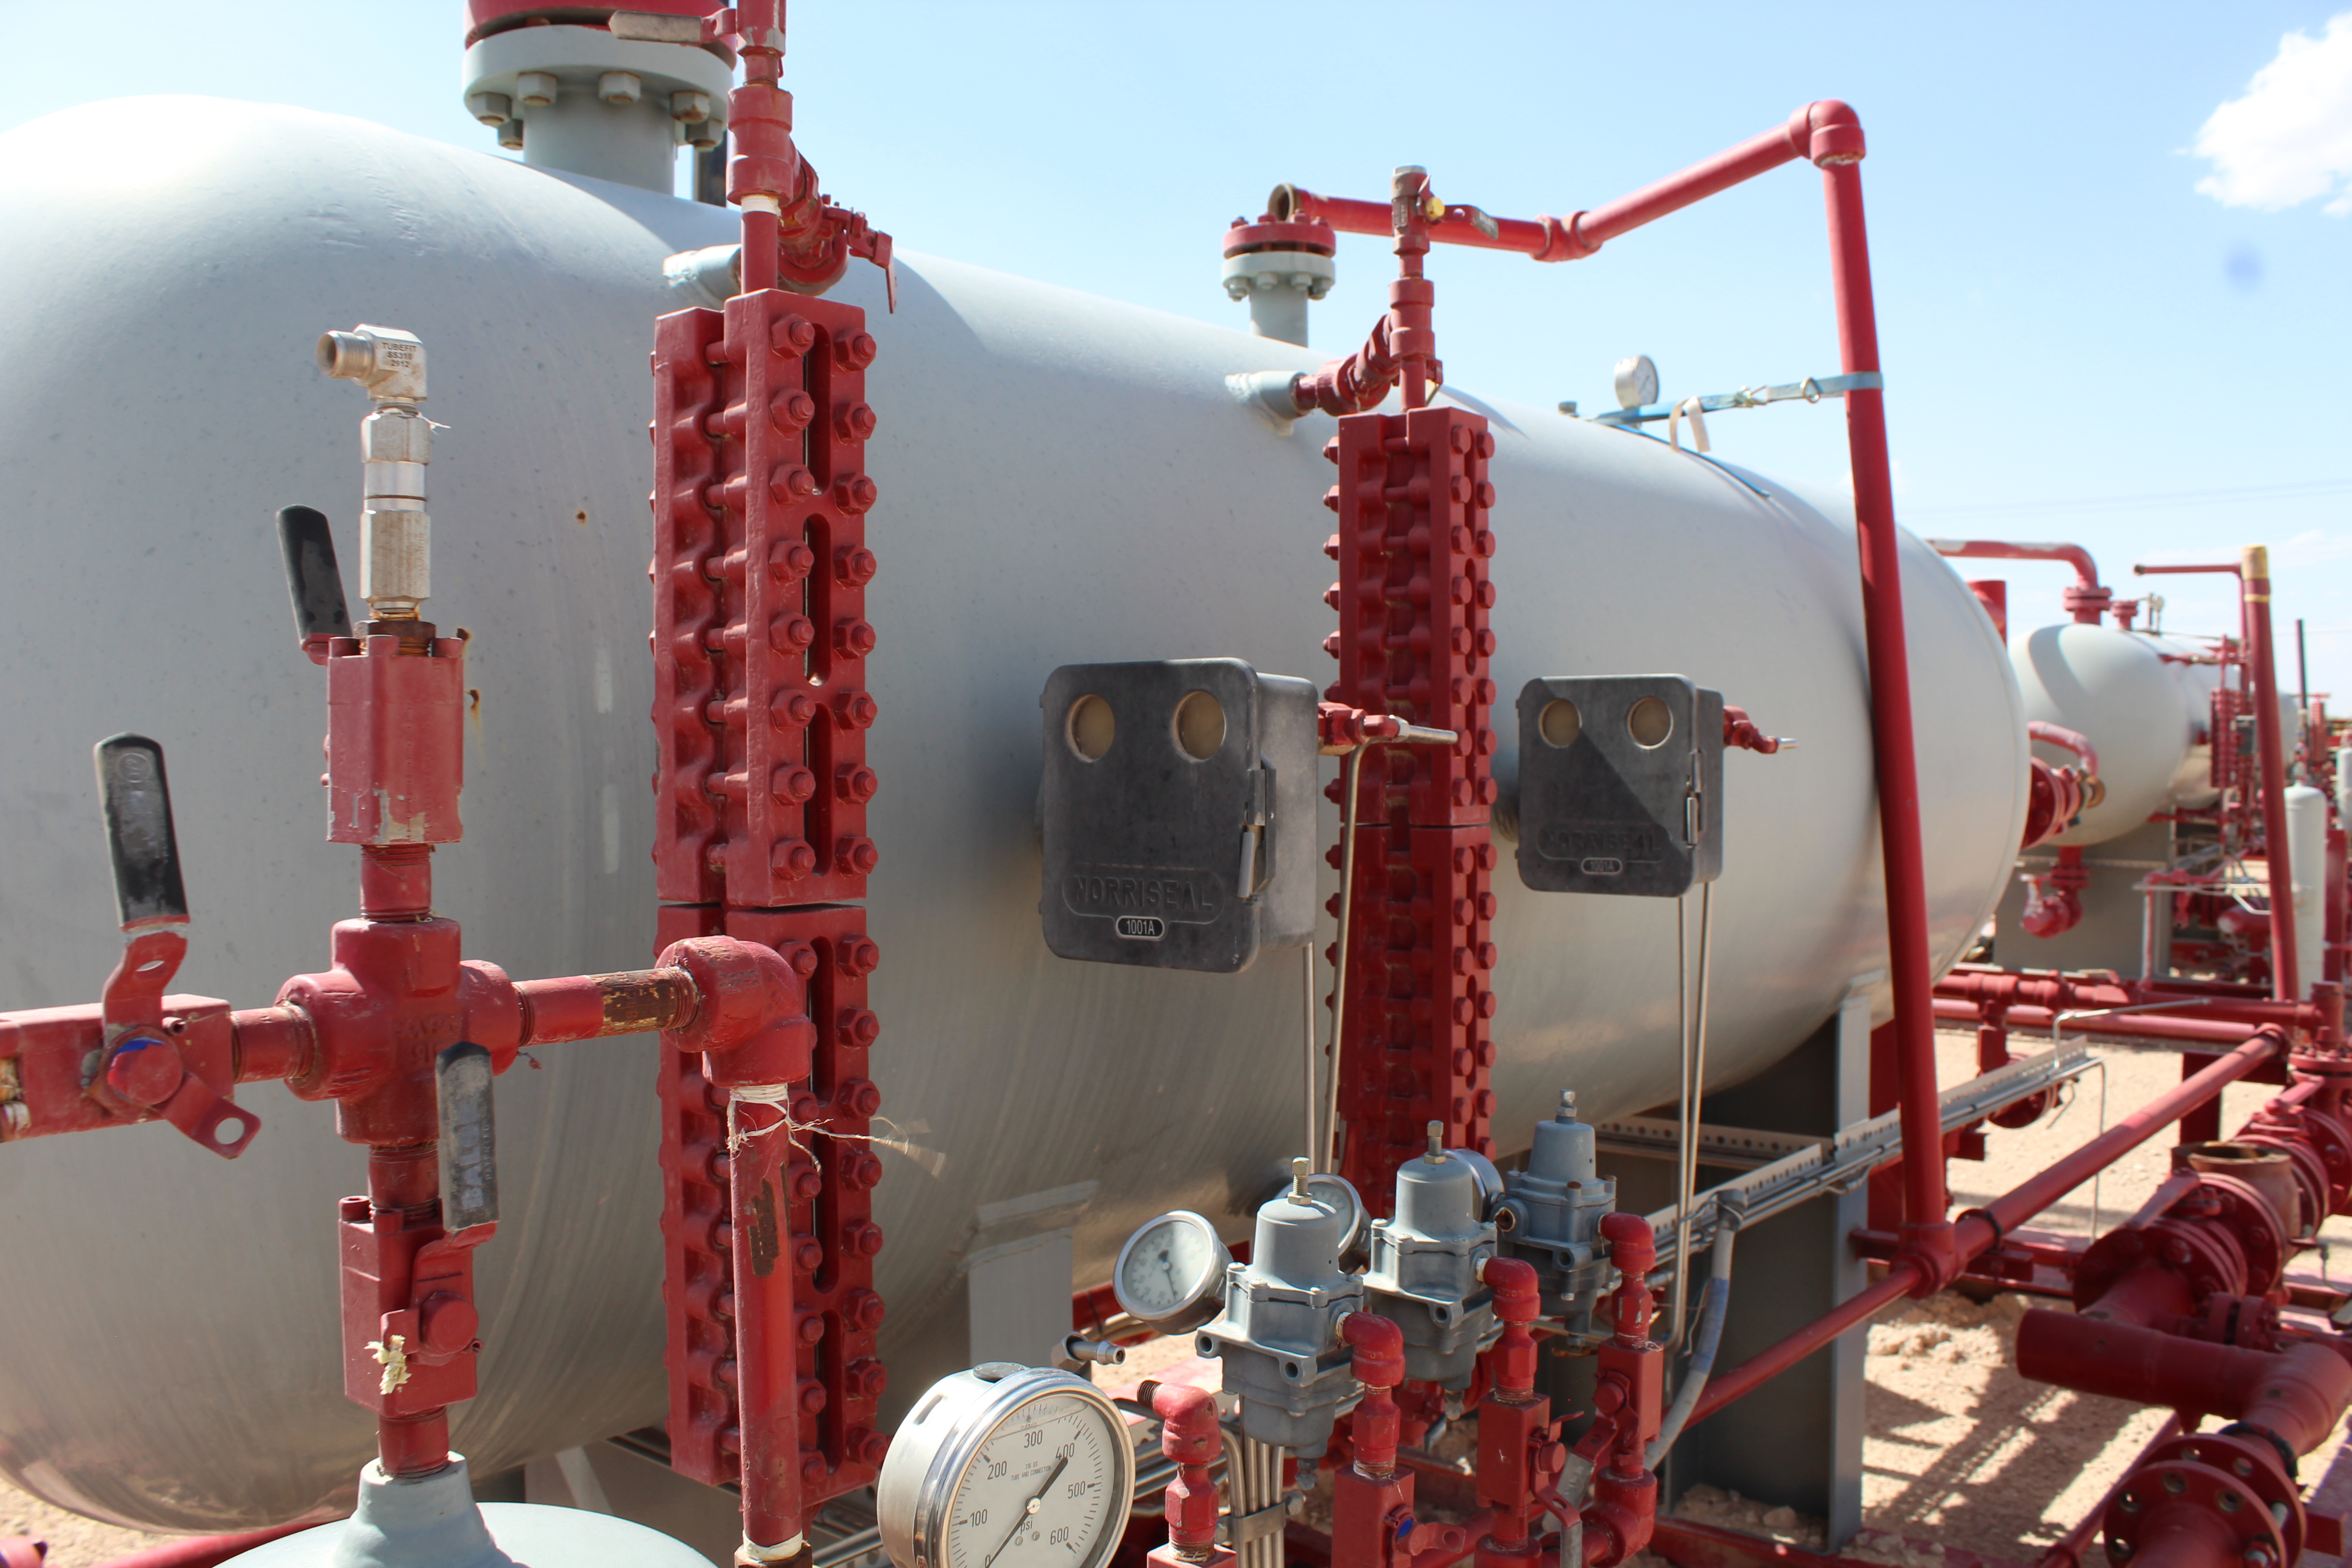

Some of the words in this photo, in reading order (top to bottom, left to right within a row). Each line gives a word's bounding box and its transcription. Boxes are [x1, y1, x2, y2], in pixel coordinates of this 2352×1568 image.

[382, 342, 417, 352] TUBEFIT
[1073, 874, 1213, 911] NORRISEAL
[1126, 919, 1155, 935] 1001A
[1024, 1430, 1043, 1448] 300
[1055, 1442, 1075, 1461] 400
[987, 1460, 1007, 1480] 200
[1030, 1465, 1052, 1476] CONNECTION
[1068, 1480, 1086, 1499] 500
[970, 1509, 988, 1528] 100
[1020, 1516, 1033, 1535] psi
[1050, 1526, 1069, 1545] 600
